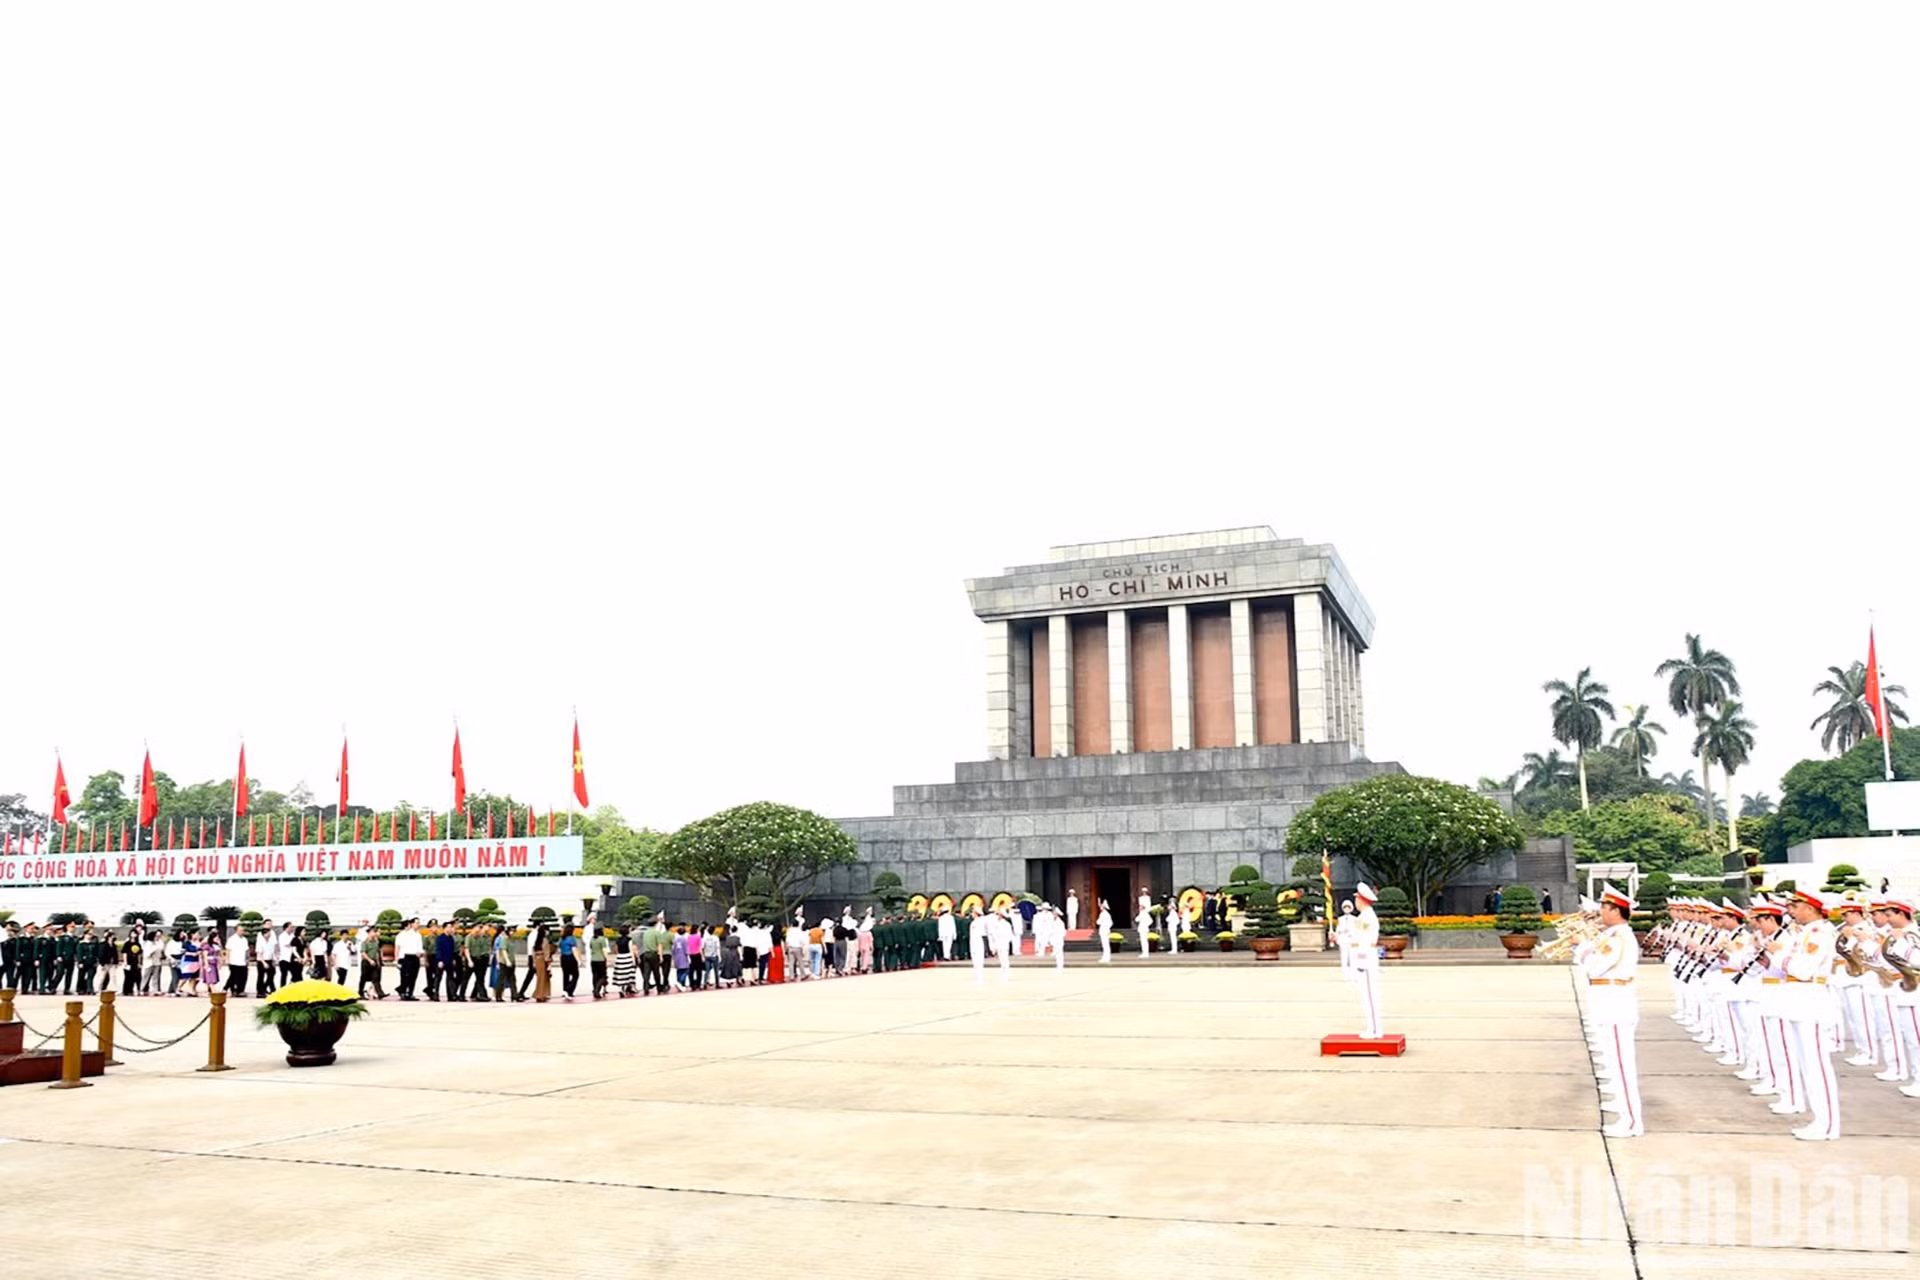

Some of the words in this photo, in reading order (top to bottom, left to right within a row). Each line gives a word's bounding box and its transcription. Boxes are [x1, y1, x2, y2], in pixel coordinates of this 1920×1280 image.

[23, 857, 67, 883] CỘNG
[115, 854, 138, 877] XÃ
[145, 853, 175, 879] HỘI
[183, 850, 219, 875] CHỦ
[228, 849, 286, 874] NGHĨA
[297, 847, 339, 875] VIỆT
[348, 849, 395, 871] NAM
[404, 843, 467, 869] MUÔN
[477, 841, 528, 868] NĂM
